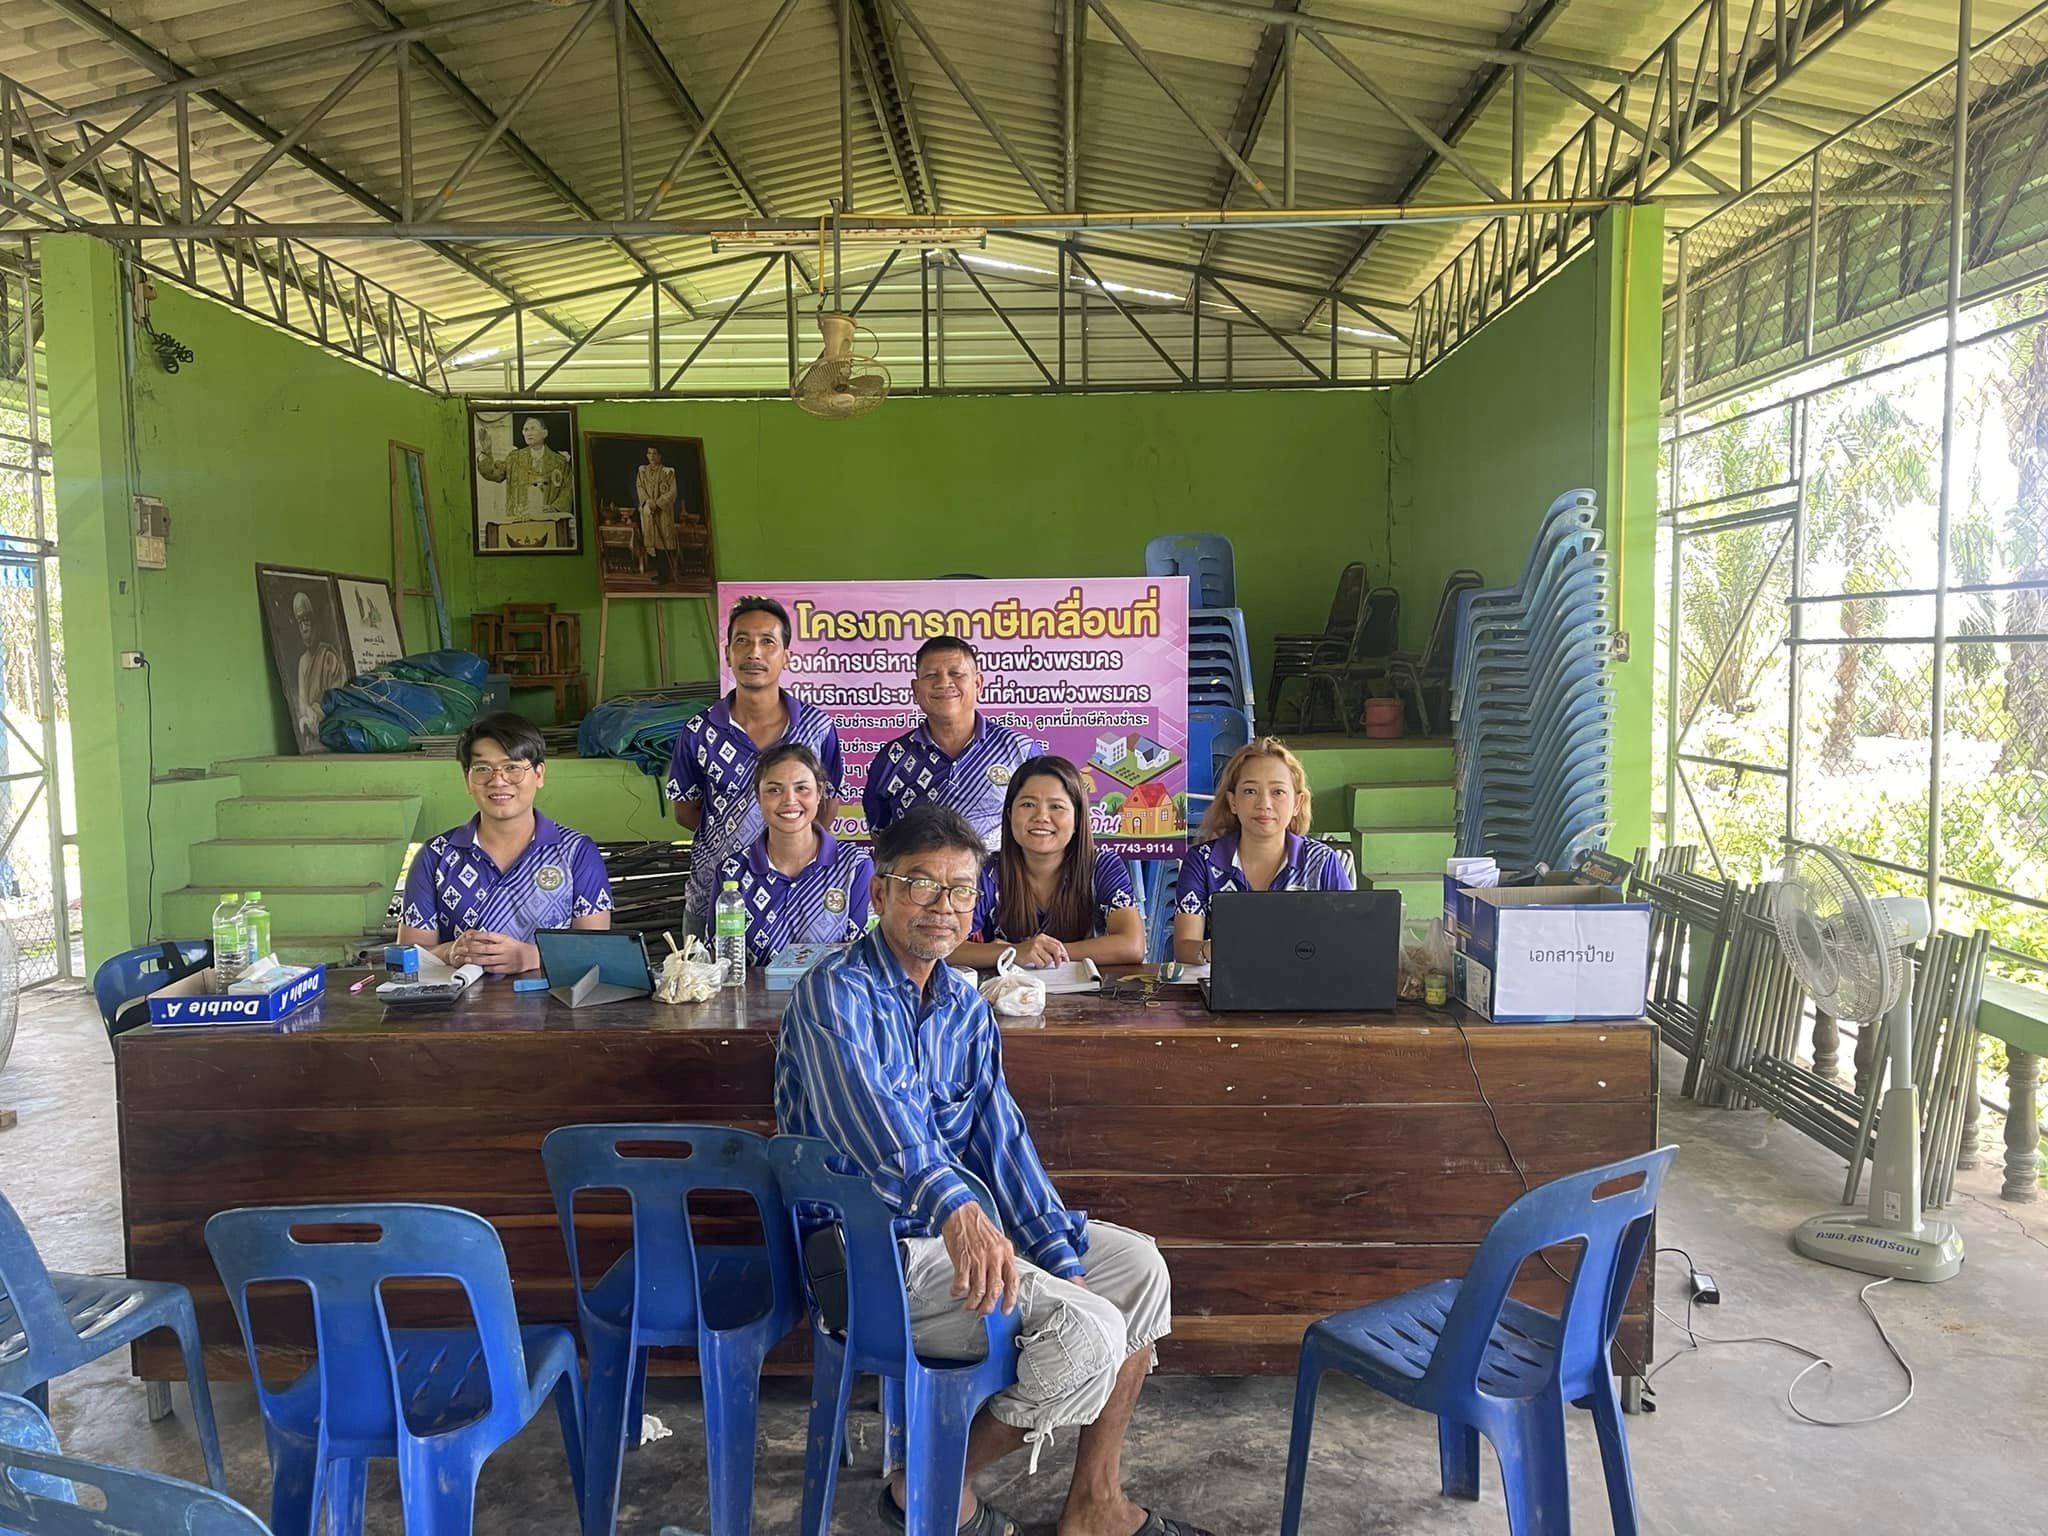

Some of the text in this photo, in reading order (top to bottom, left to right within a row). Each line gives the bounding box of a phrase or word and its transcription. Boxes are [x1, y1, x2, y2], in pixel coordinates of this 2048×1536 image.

[796, 587, 1159, 640] โครงการภาษีเคลื่อนที่
[1529, 944, 1615, 963] เอกสารป้าย
[281, 973, 319, 1010] Double A
[167, 1000, 260, 1018] Double A
